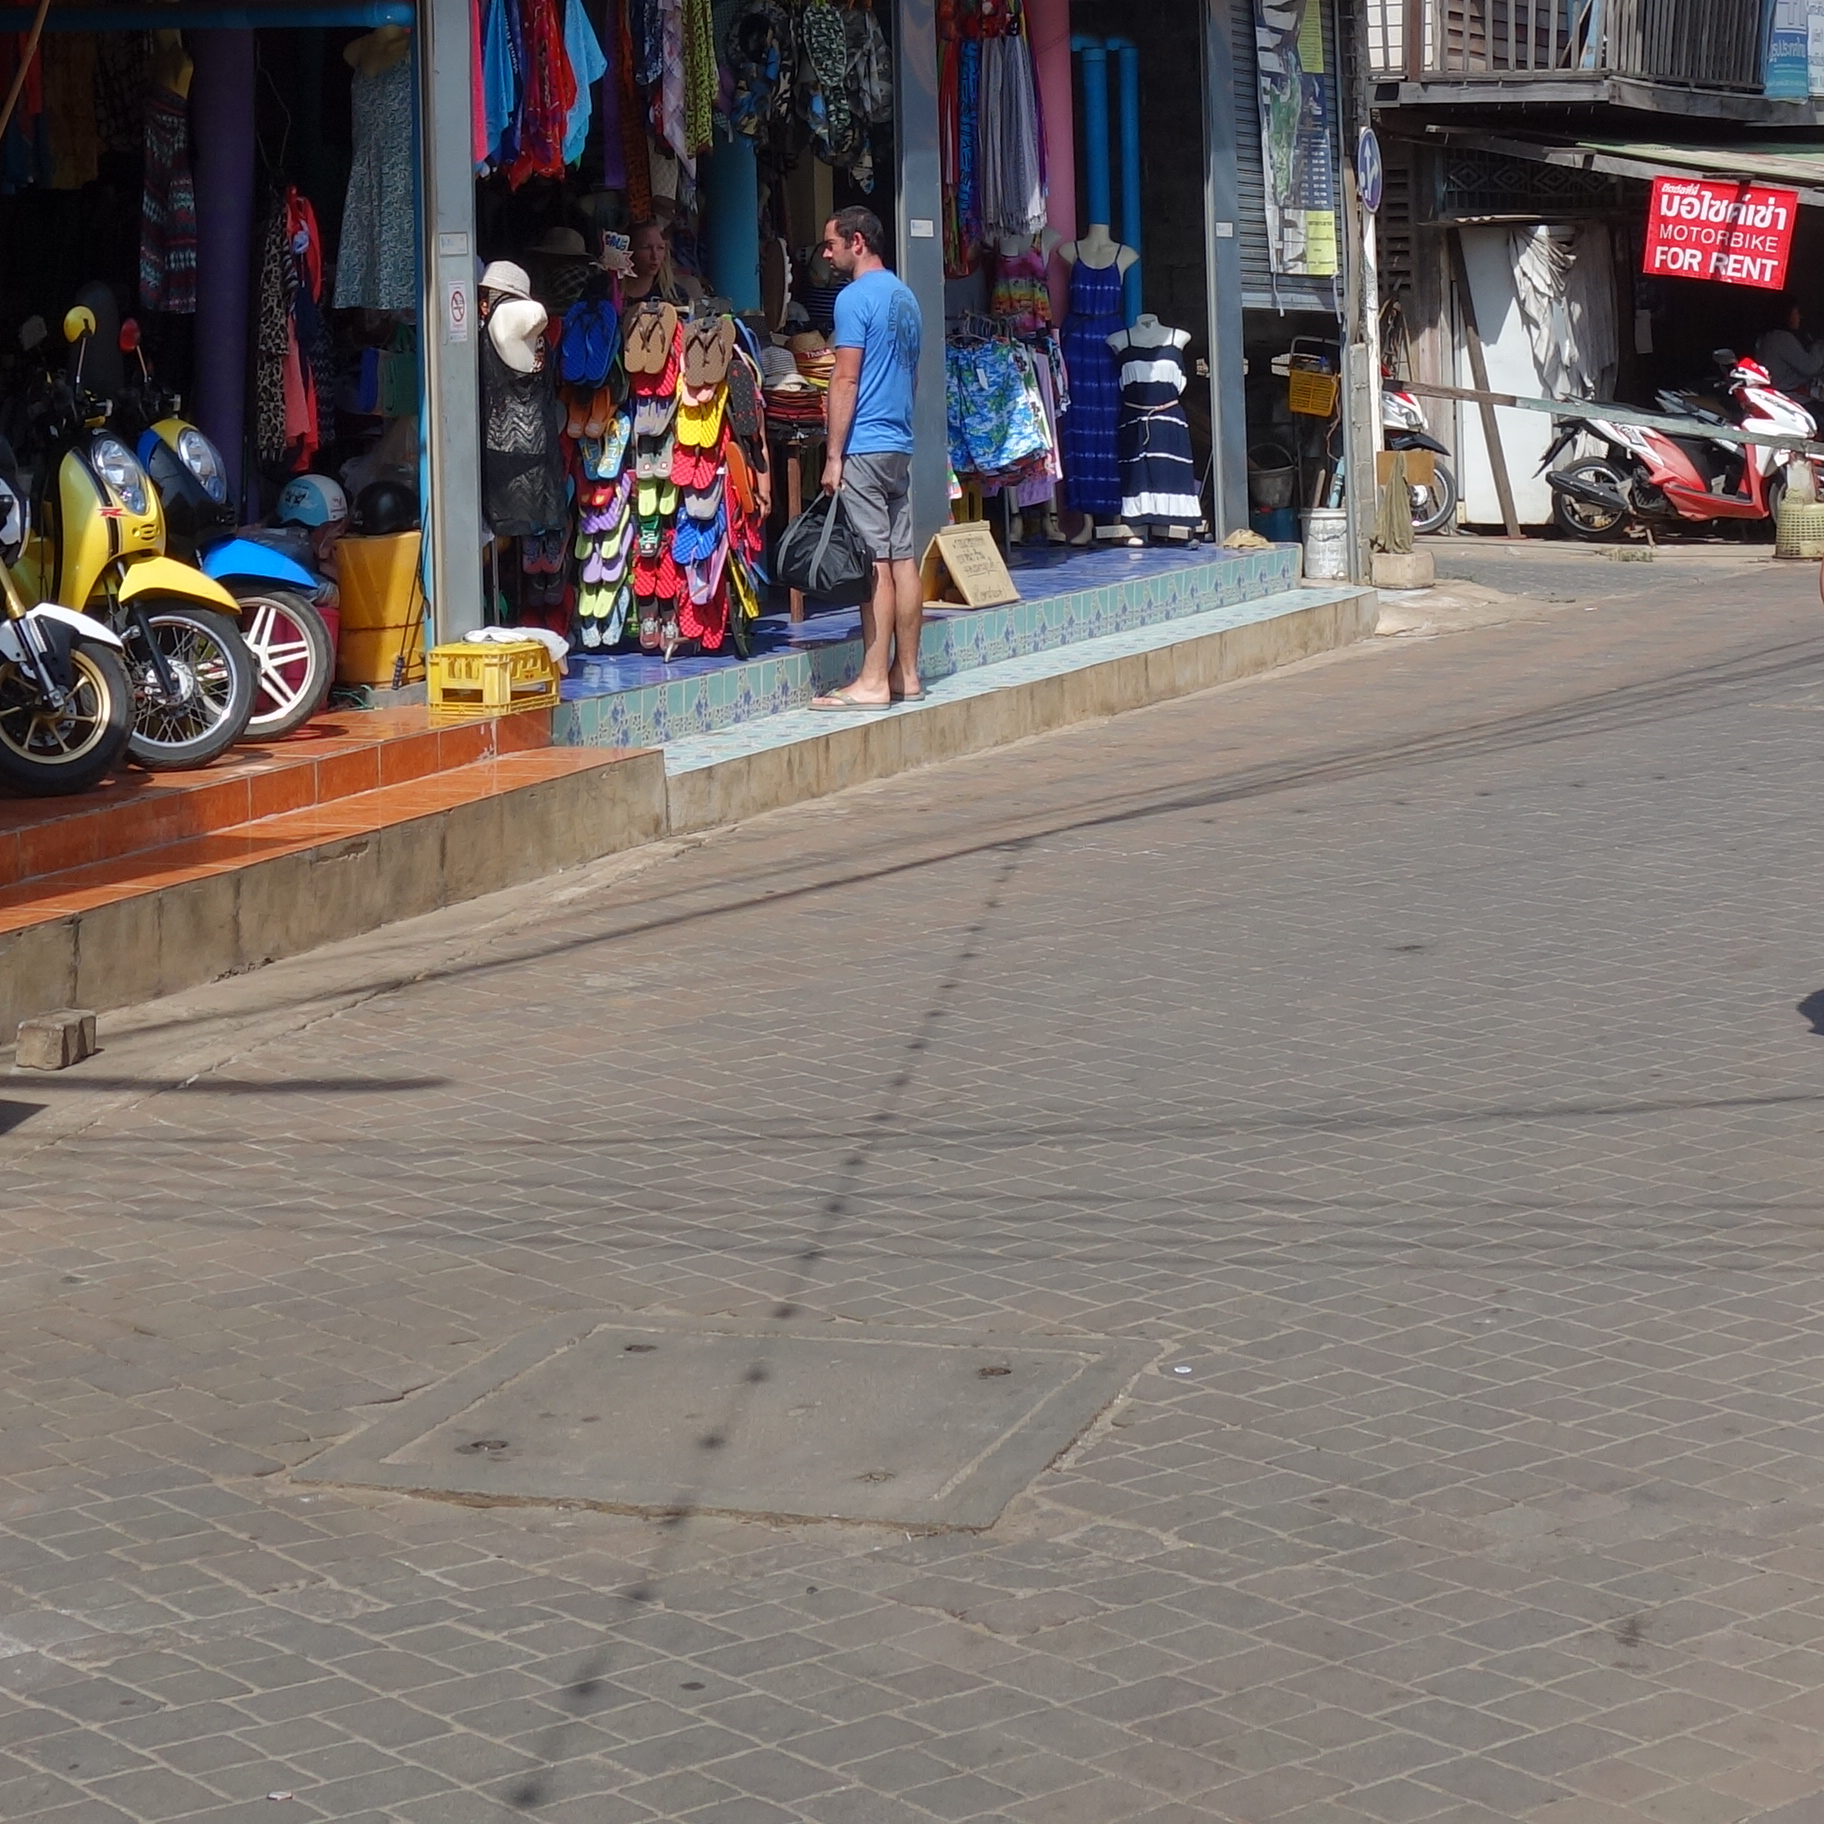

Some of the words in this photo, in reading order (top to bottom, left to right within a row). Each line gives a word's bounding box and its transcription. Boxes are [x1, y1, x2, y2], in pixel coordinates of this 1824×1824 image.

[1660, 190, 1787, 231] มอไซค์เช่า
[1659, 224, 1779, 253] MOTORBIKE
[1654, 247, 1701, 273] FOR
[1710, 251, 1778, 282] RENT
